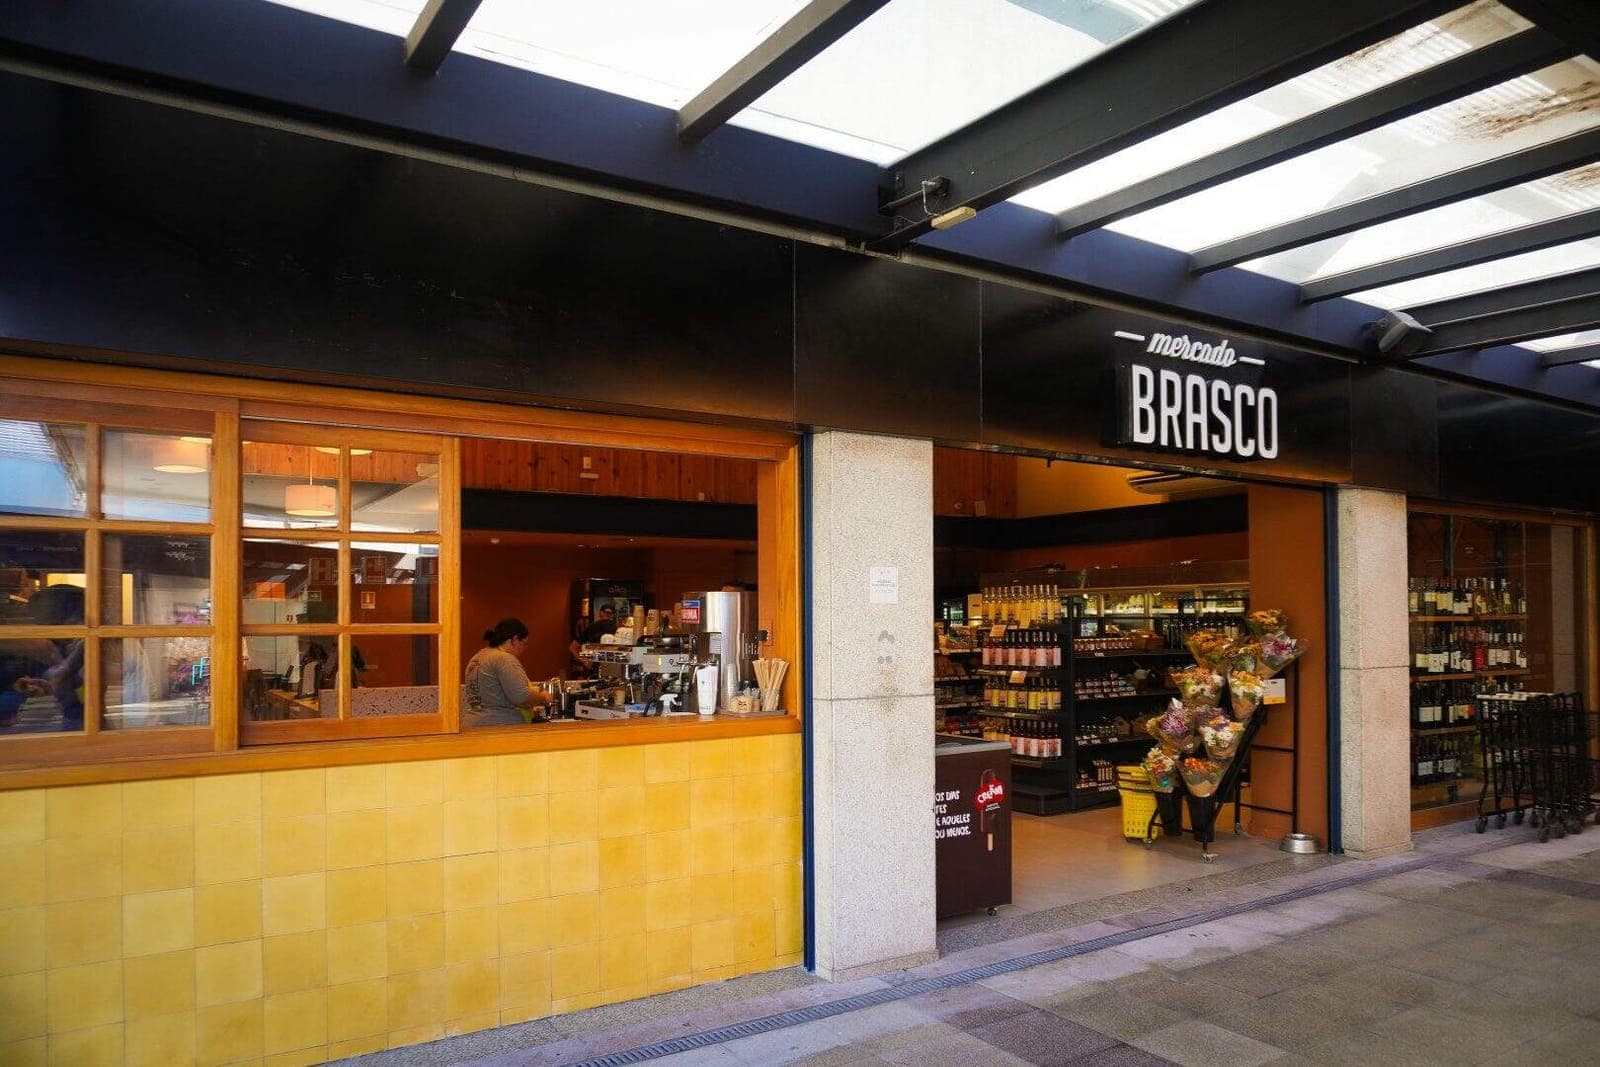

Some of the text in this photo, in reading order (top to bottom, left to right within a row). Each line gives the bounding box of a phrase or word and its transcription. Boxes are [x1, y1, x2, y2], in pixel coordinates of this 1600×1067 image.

[1146, 333, 1237, 368] mercado
[1132, 364, 1278, 460] BRASCO
[942, 813, 971, 826] AQUELES
